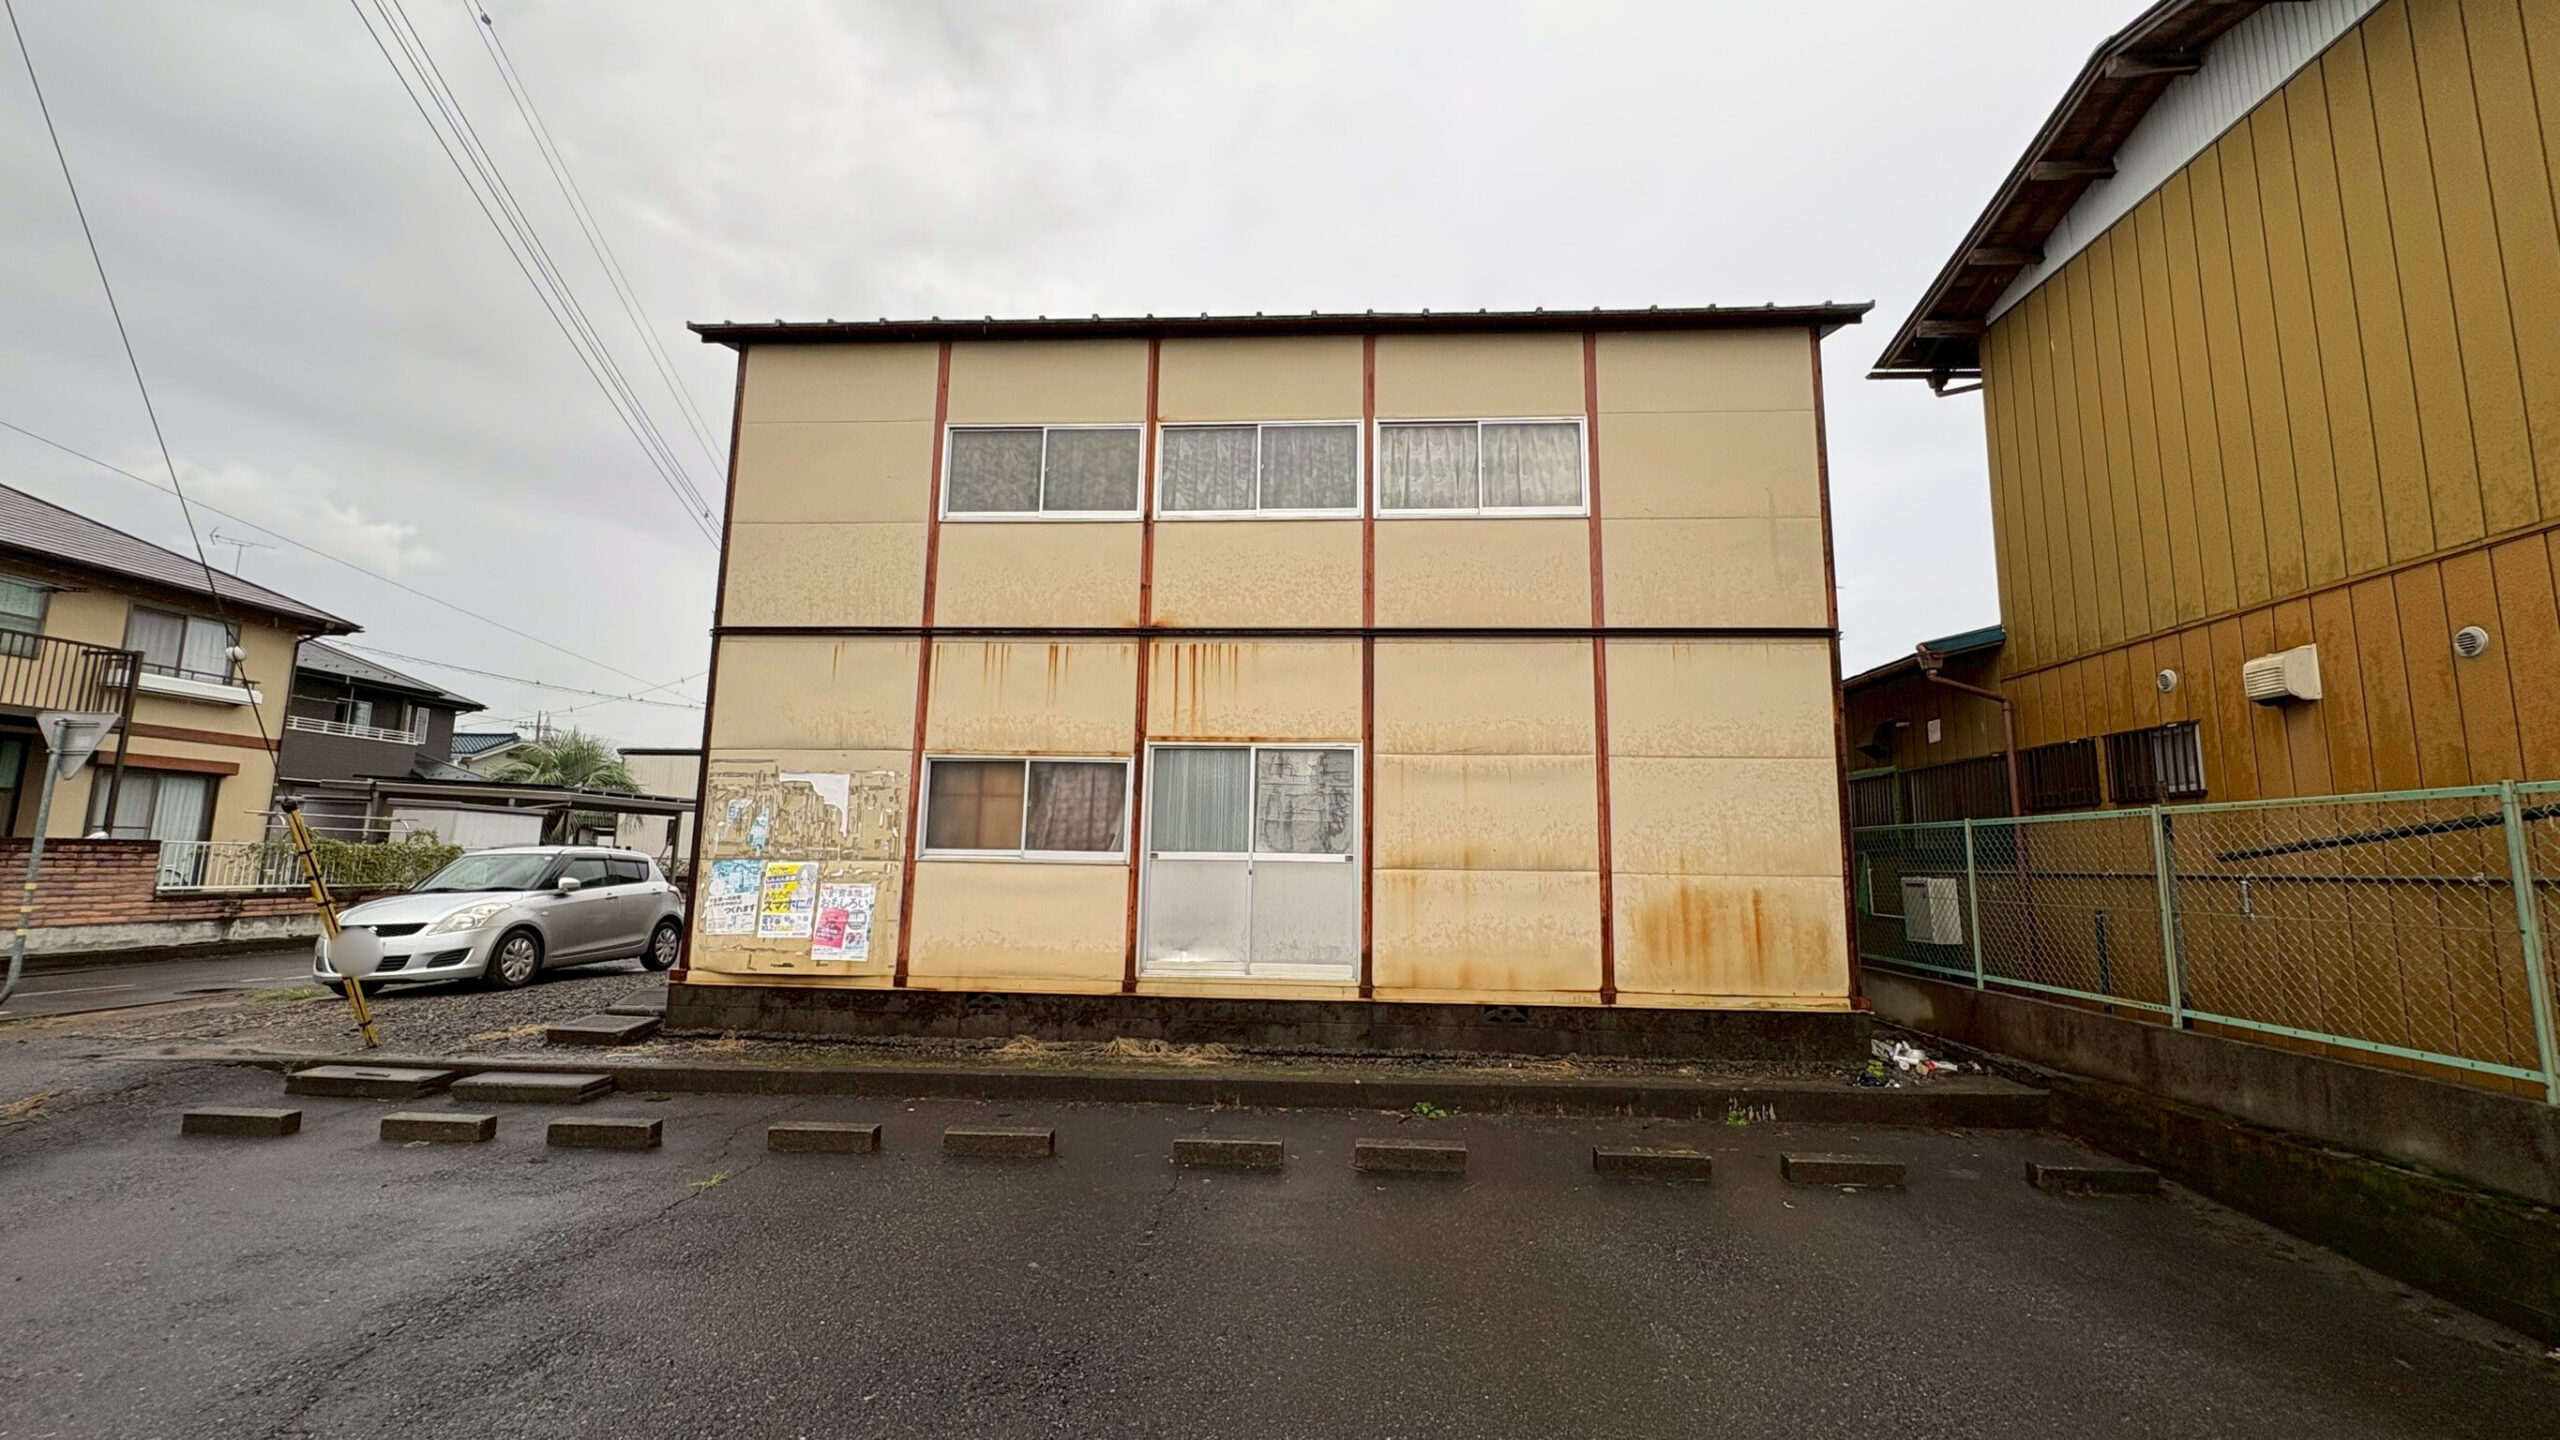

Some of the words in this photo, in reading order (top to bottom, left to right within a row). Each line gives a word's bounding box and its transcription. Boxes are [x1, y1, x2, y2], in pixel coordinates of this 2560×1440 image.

[724, 903, 756, 914] つくれます
[820, 897, 868, 909] おもしろい
